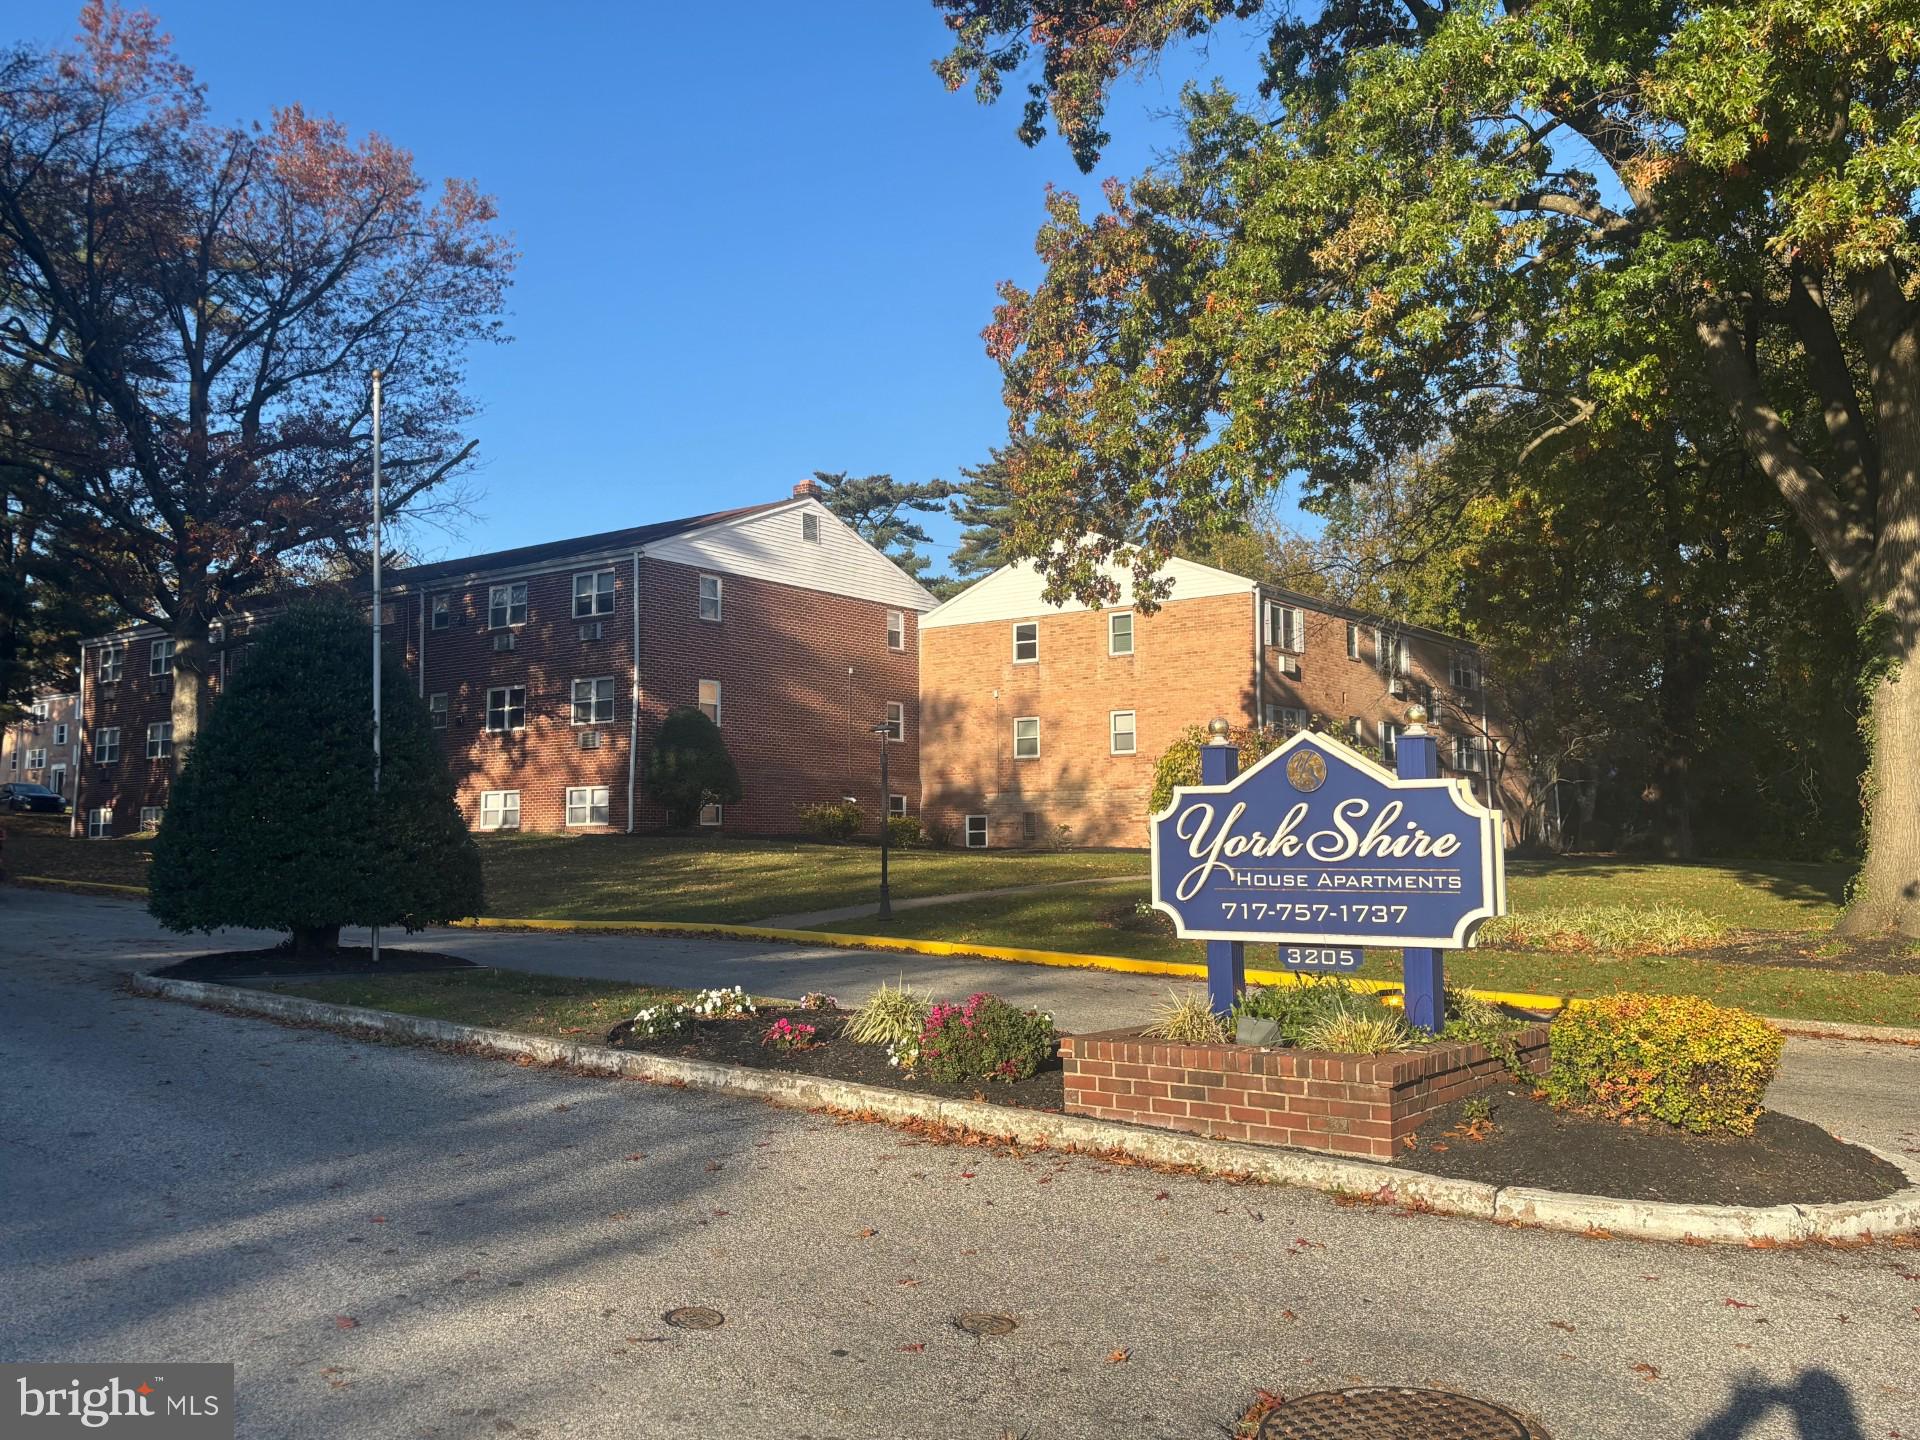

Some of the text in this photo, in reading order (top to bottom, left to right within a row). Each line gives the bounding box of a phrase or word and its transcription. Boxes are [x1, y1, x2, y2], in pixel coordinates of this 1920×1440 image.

[1176, 798, 1461, 901] York Shire
[1221, 902, 1409, 924] 717-757-1737
[1287, 948, 1355, 966] 3205
